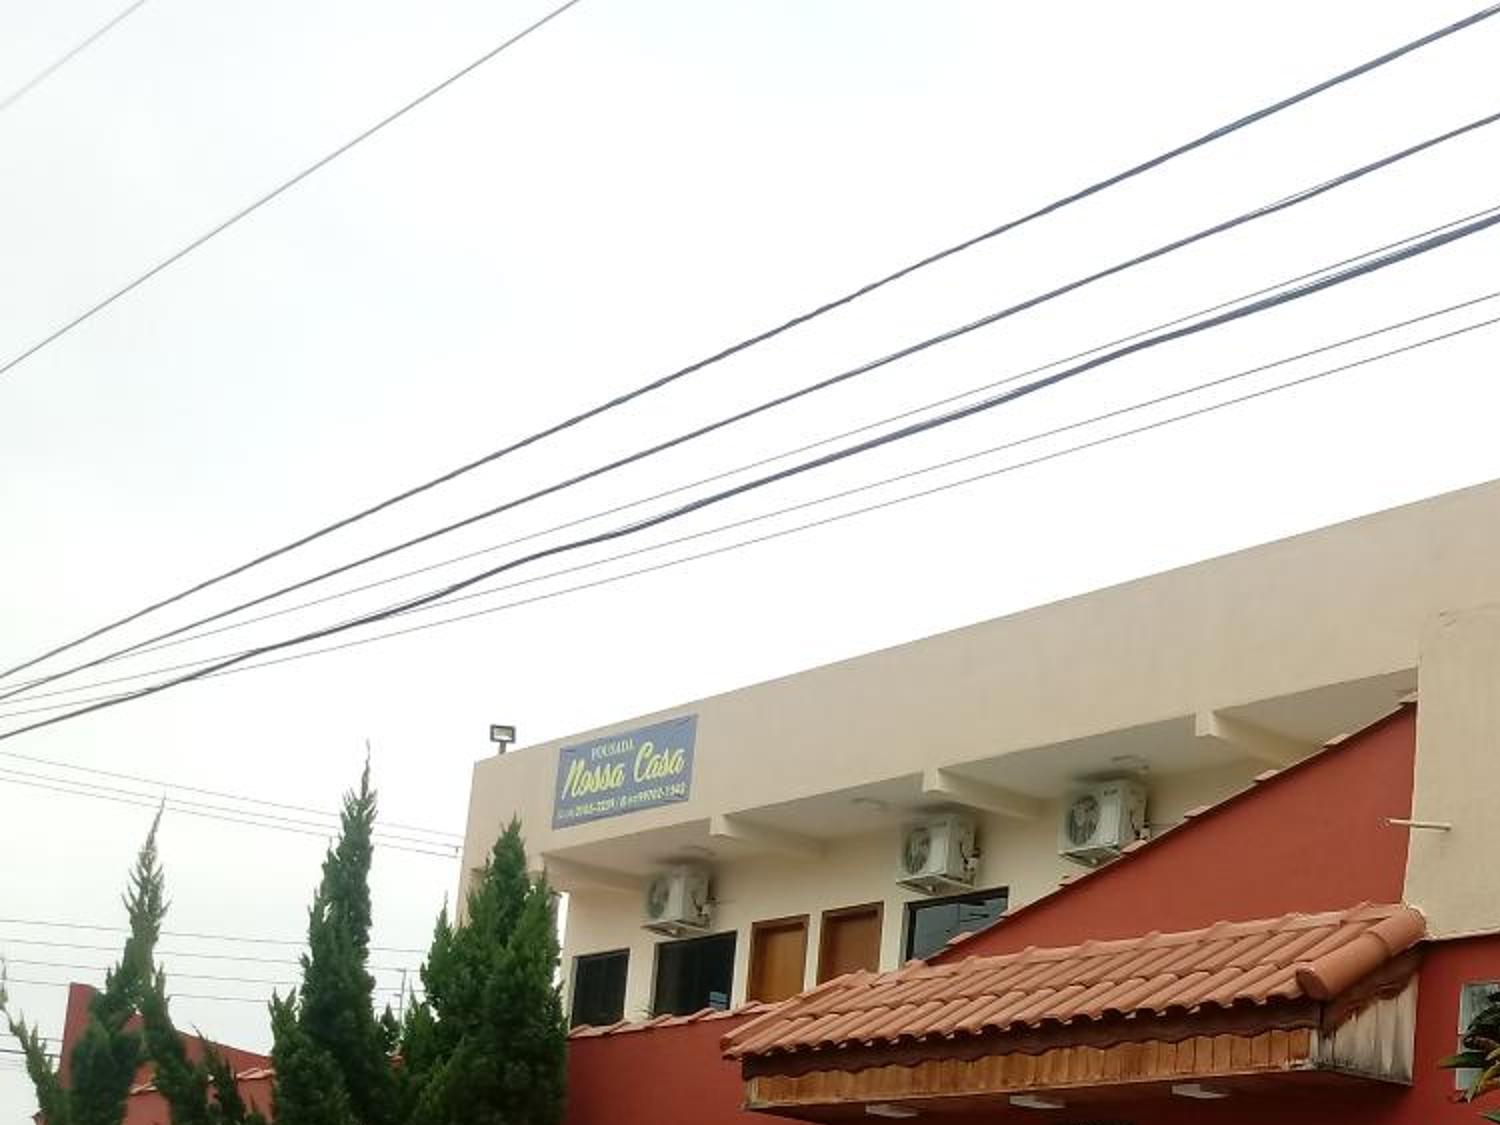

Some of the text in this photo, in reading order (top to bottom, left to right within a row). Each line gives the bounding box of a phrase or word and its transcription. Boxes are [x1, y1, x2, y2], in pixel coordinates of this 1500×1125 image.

[591, 739, 634, 760] POUSADA
[562, 741, 685, 800] Nossa Casa
